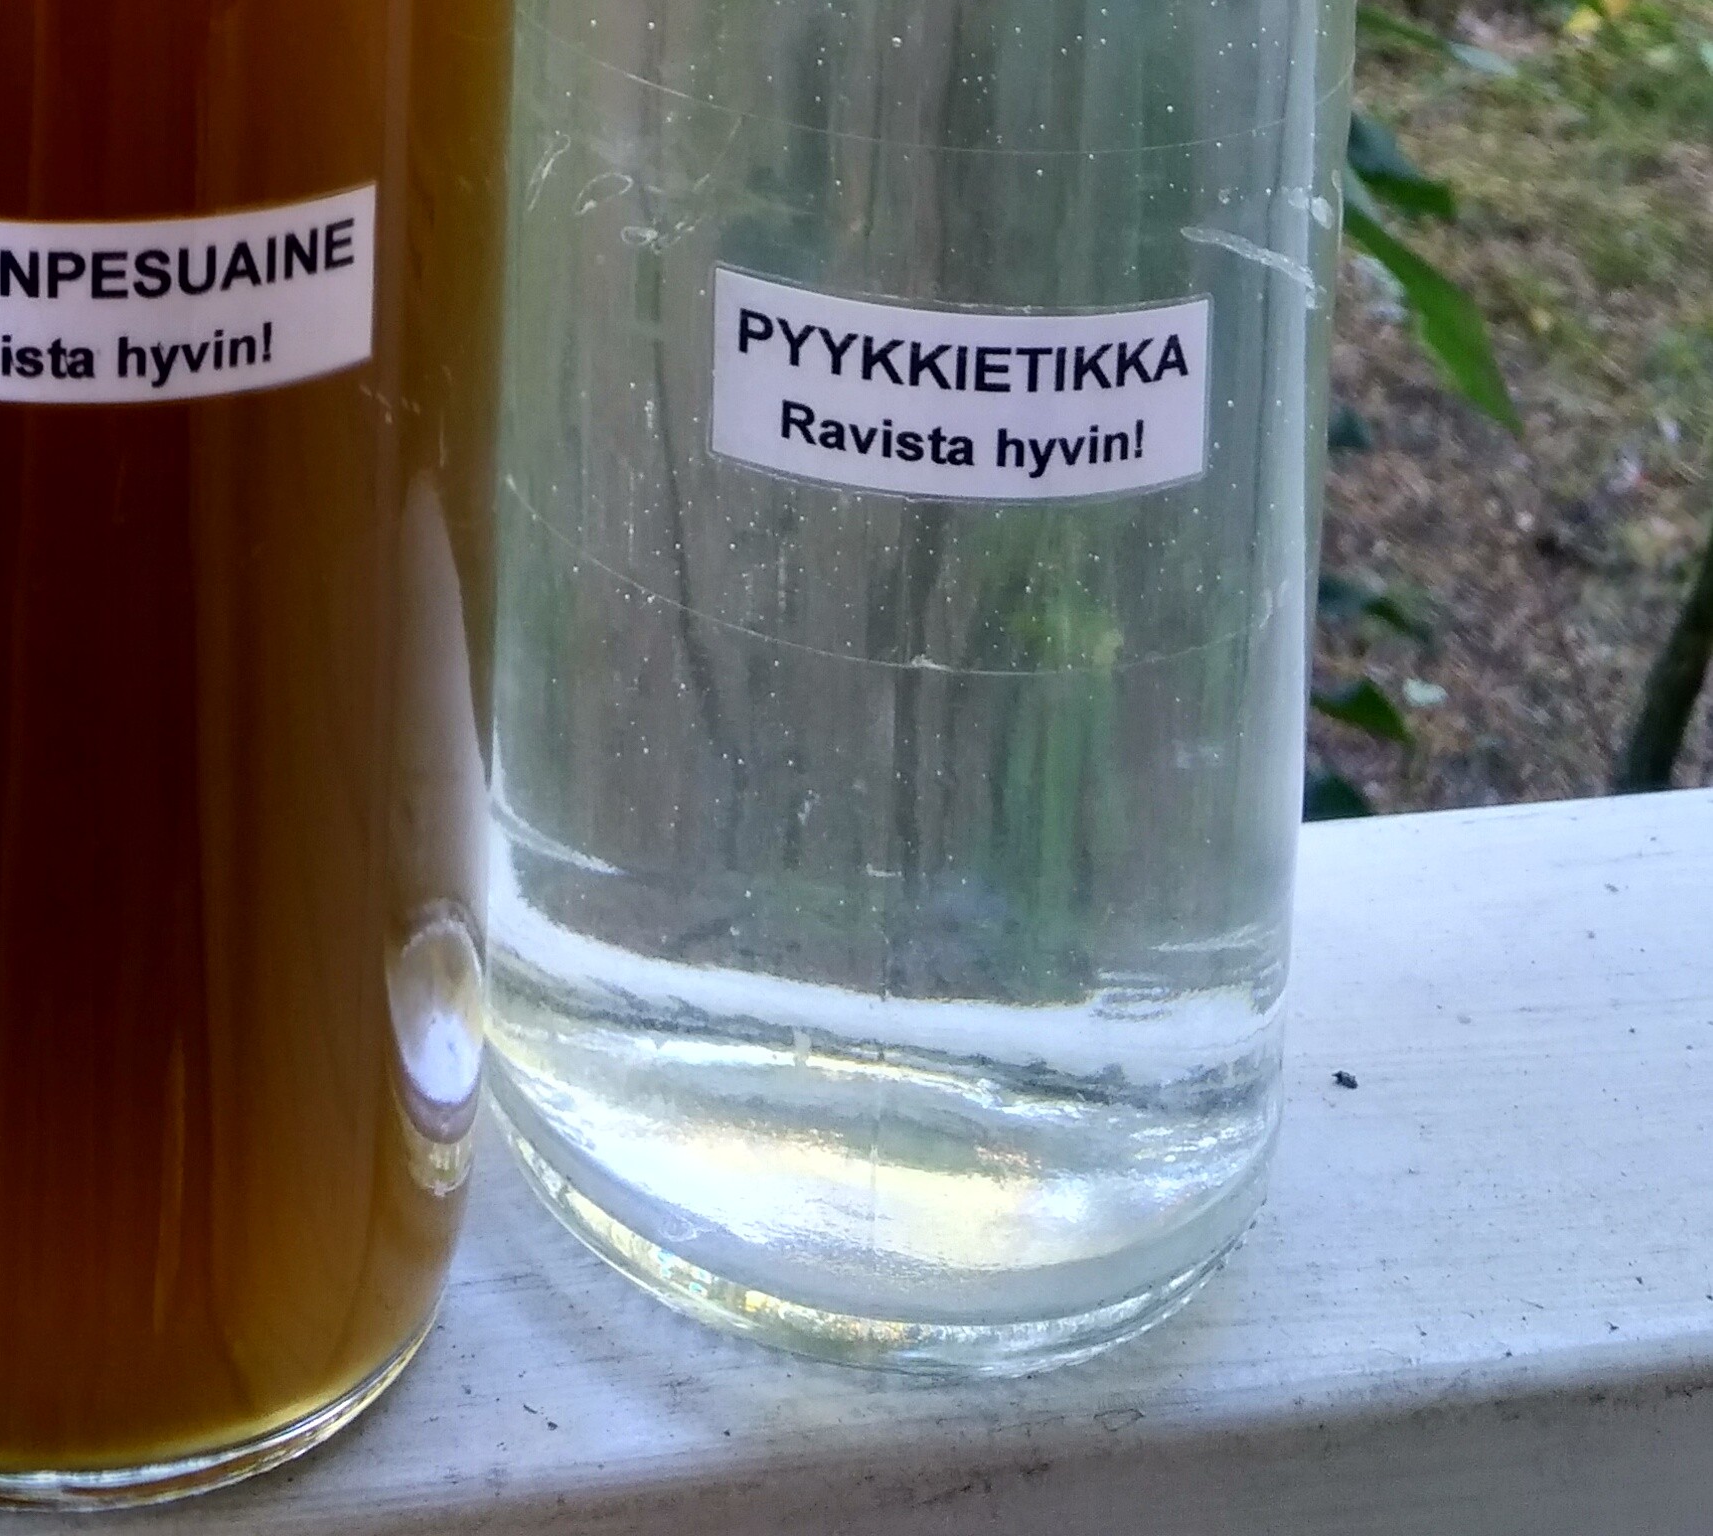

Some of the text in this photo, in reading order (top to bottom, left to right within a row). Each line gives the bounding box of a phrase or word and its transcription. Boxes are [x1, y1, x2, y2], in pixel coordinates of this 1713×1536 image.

[117, 322, 273, 388] hyvin!
[738, 308, 1189, 393] PYYKKIETIKKA
[780, 400, 1145, 478] Ravista hyvin!
